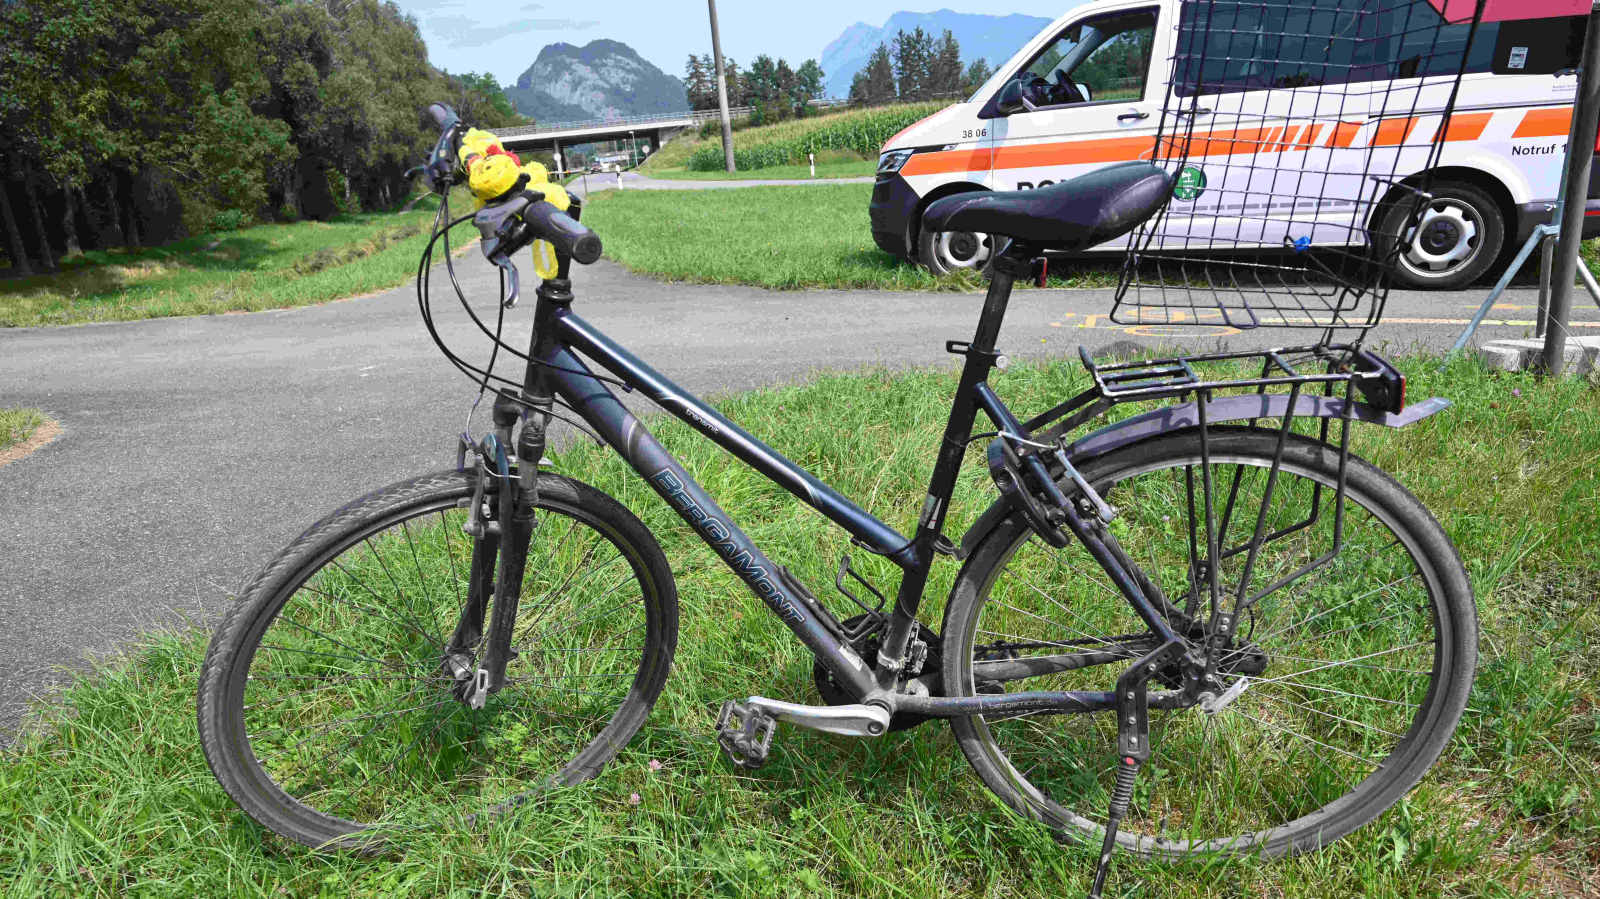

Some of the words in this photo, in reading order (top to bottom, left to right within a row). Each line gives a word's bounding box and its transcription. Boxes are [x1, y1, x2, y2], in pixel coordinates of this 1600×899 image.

[962, 129, 973, 139] 38
[975, 128, 987, 138] 06
[1511, 143, 1556, 156] Notruf
[685, 408, 719, 435] transmit
